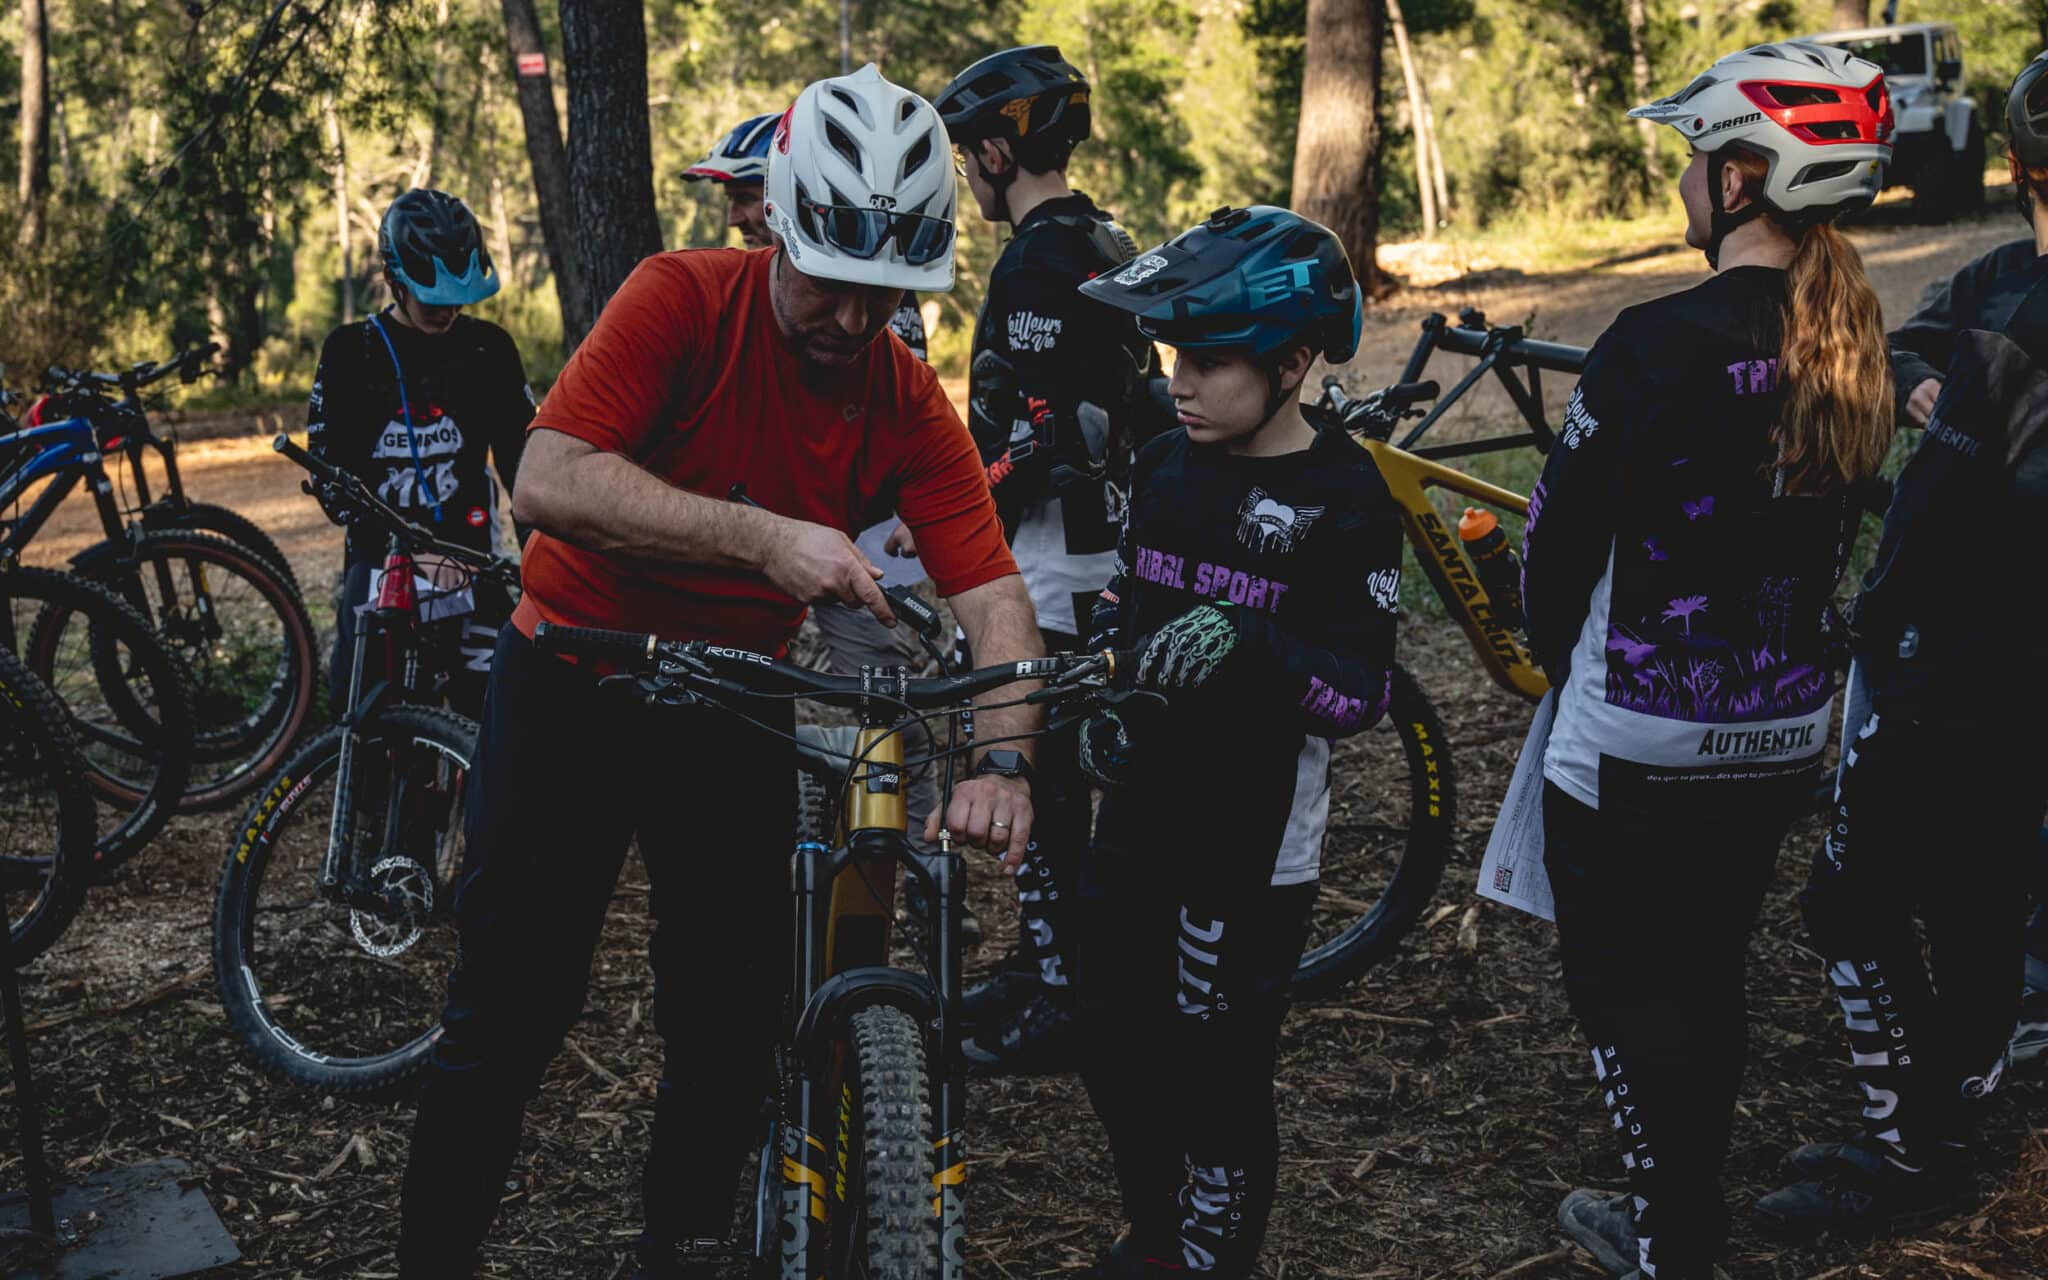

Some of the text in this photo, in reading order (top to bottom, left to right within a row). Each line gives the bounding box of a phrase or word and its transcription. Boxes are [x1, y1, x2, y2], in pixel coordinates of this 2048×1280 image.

[1711, 112, 1763, 133] SRAM
[1194, 561, 1288, 616] SPORT
[1416, 512, 1479, 601] SANTA
[1410, 721, 1441, 818] MAXXIS
[1697, 723, 1815, 757] AUTHENTIC
[235, 775, 293, 864] MAXXIS
[1861, 958, 1913, 1067] BICYCLE
[834, 1081, 852, 1203] MAXXIS
[1604, 1043, 1656, 1170] BICYCLE
